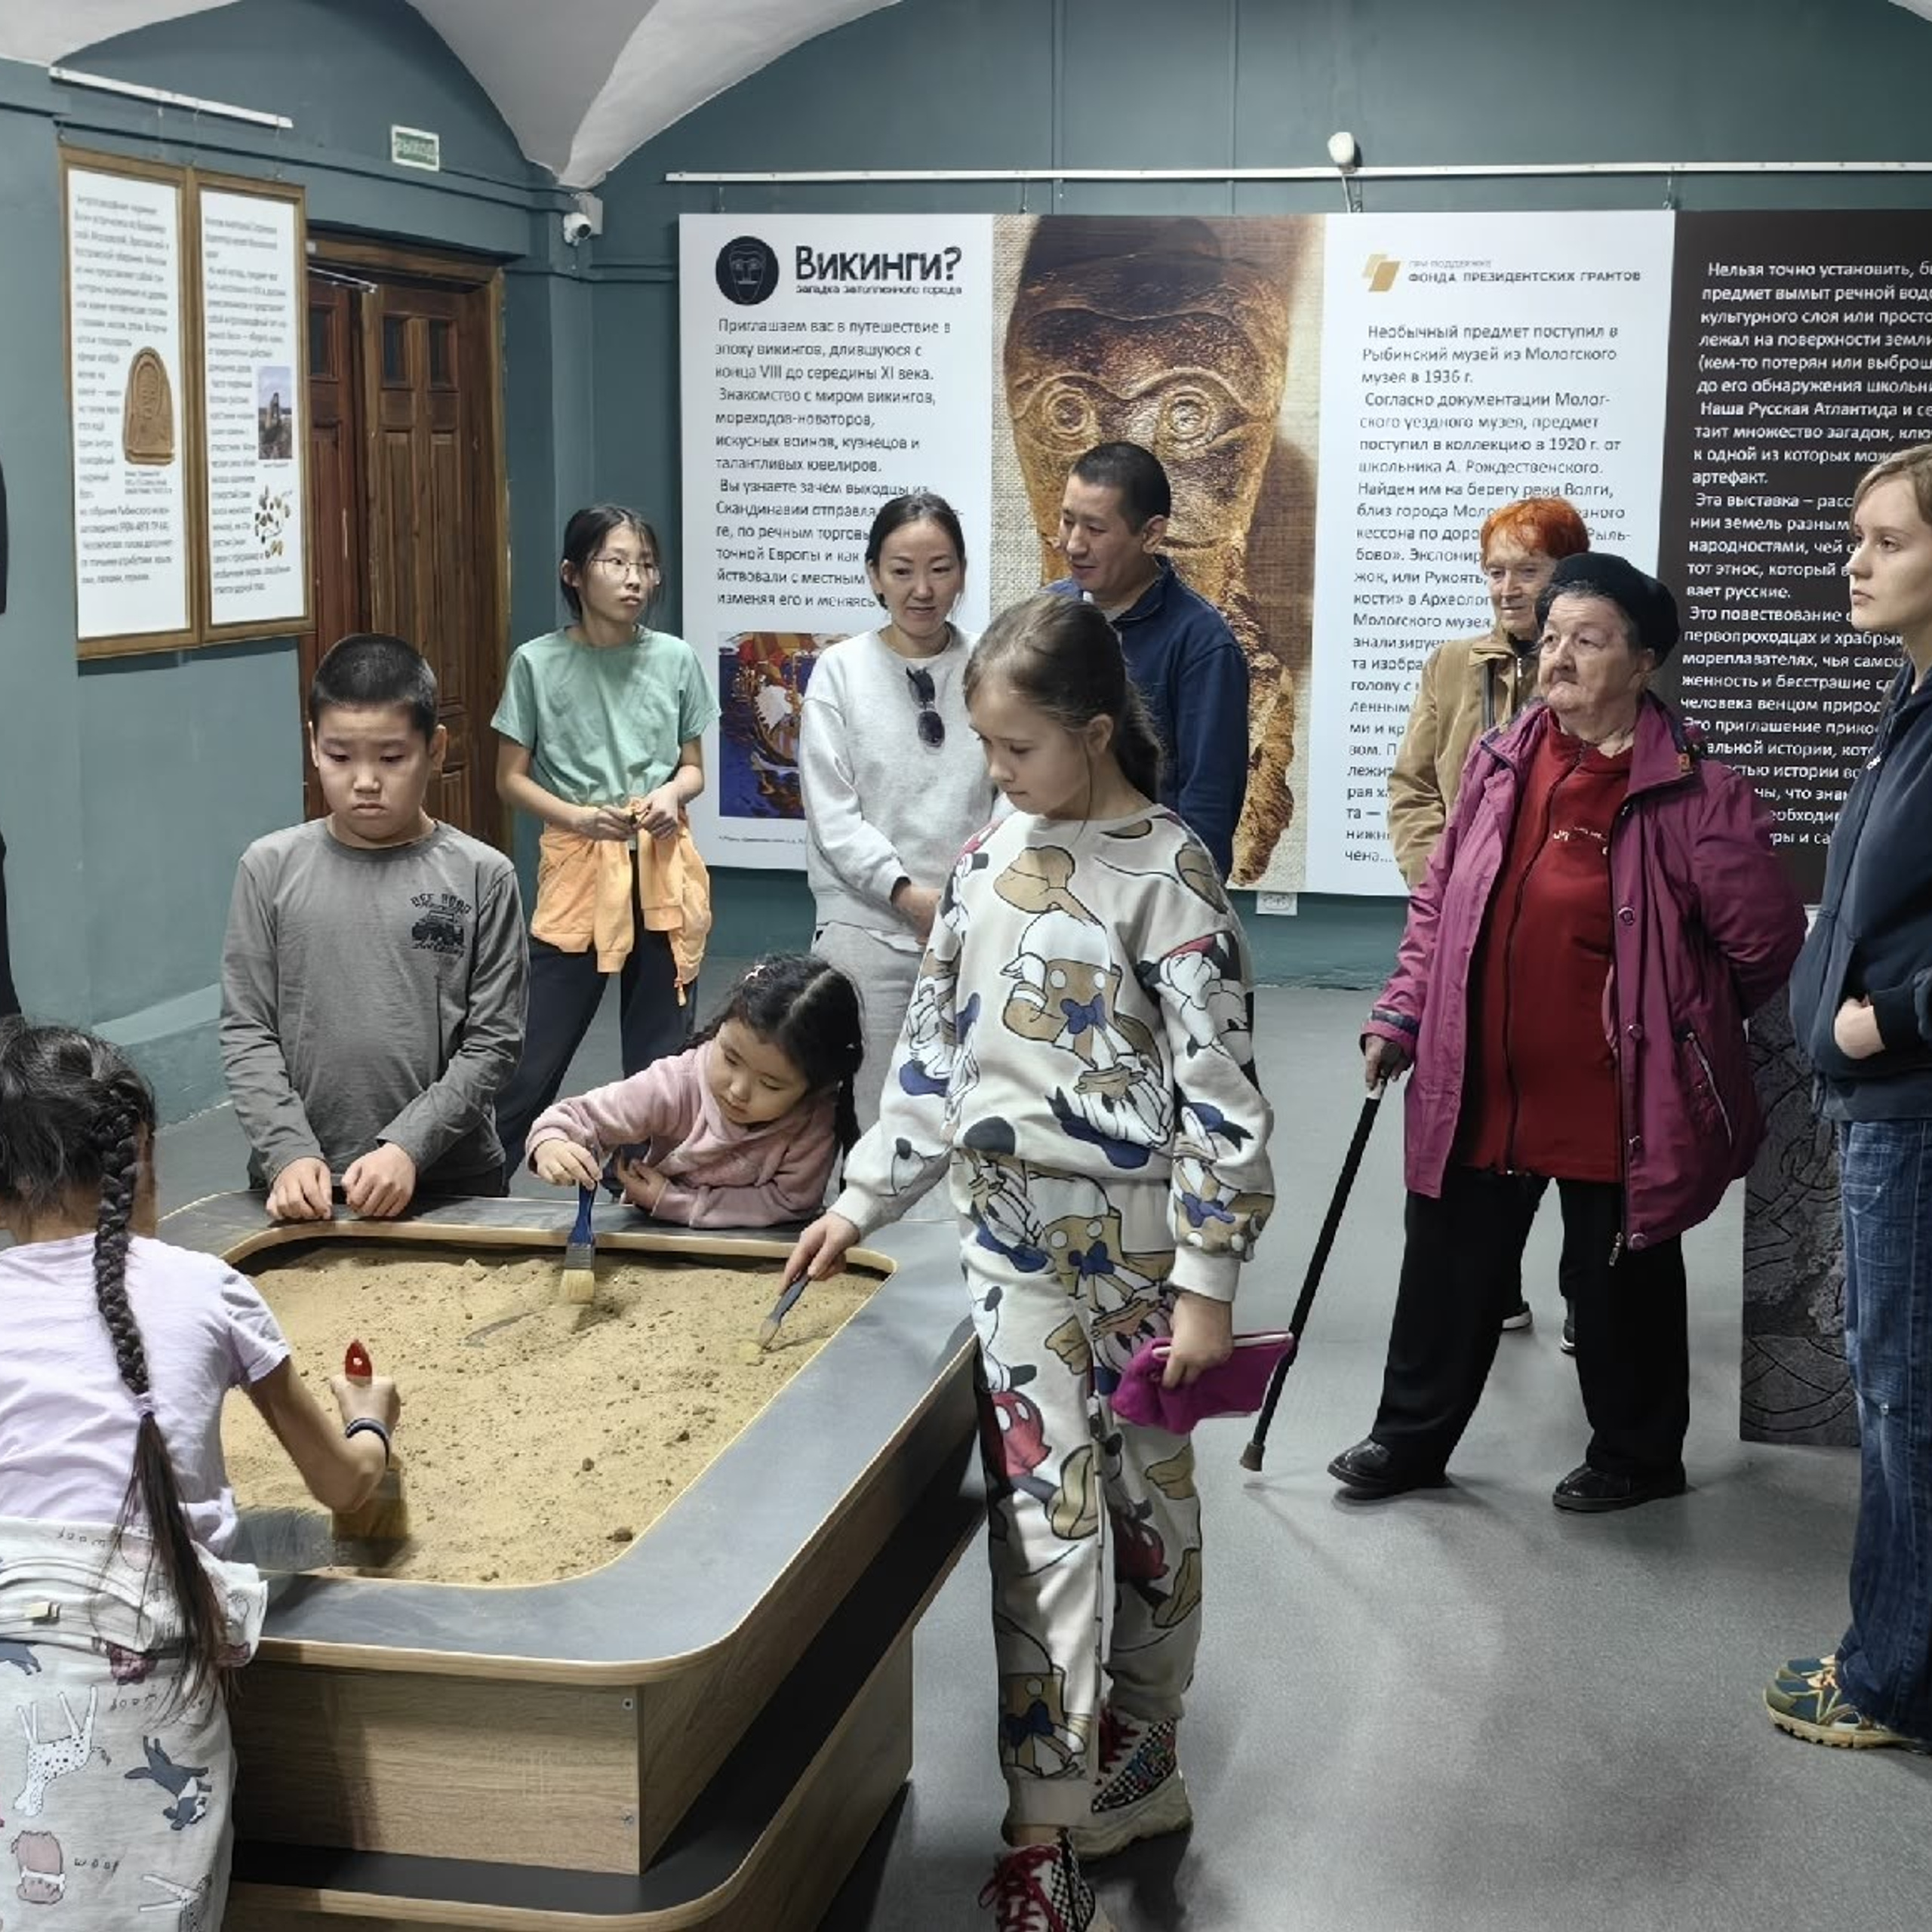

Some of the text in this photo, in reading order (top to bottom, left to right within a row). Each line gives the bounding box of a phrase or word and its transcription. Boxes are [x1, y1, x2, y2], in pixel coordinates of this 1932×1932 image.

[796, 245, 962, 281] Викинги?
[1708, 263, 1914, 278] Нельзя точно установить,
[1408, 272, 1641, 283] ФОНДА ПРЕЗИДЕНТСКИХ ГРАНТОВ
[1702, 285, 1895, 302] предмет вымыт речной
[718, 318, 950, 334] Приглашаем вас в путешествие в
[1700, 312, 1798, 326] культурного
[1801, 312, 1838, 322] слоя
[1843, 312, 1874, 322] или
[1368, 325, 1618, 340] Необычный предмет поступил в
[1699, 334, 1881, 349] лежал на поверхности
[715, 345, 921, 358] эпоху викингов, длившуюся с
[1362, 346, 1617, 362] Рыбинский музей из Мологского
[1698, 354, 1862, 371] (кем-то потерян или
[715, 365, 933, 381] конца VIII до середины XI века.
[1361, 369, 1472, 385] музея в 1936 г.
[1697, 377, 1862, 394] до его обнаружения
[718, 388, 935, 405] Знакомство с миром викингов,
[1364, 392, 1609, 408] Согласно документации Молог-
[1700, 401, 1912, 418] Наша Русская Атлантида и
[715, 414, 875, 426] мореходов-новаторов,
[1360, 417, 1598, 430] ского уездного музея, предмет
[1694, 426, 1894, 441] таит множество загадок,
[715, 436, 919, 450] искусных воинов, кузнецов и
[1360, 438, 1621, 453] поступил в коллекцию в 1920 г. от
[1694, 446, 1850, 464] к одной из которых
[715, 459, 881, 472] талантливых ювелиров.
[1358, 460, 1603, 475] школьника А. Рождественского.
[1692, 470, 1767, 486] артефакт.
[721, 479, 909, 495] Вы узнаете зачем выходцы
[1358, 482, 1613, 498] Найден им на берегу реки Волги,
[1696, 492, 1799, 506] Эта выставка
[716, 501, 808, 516] Скандинавии
[1356, 503, 1447, 519] близ города
[1690, 518, 1782, 529] нии земель
[715, 526, 813, 539] ге, по речным
[1357, 529, 1438, 540] кессона по
[1356, 548, 1404, 560] бово».
[1689, 539, 1842, 554] народностями, чей
[715, 546, 764, 559] точной
[768, 548, 820, 563] Европы
[837, 552, 859, 561] как
[717, 568, 786, 582] йствовали
[1354, 572, 1387, 583] жок,
[1392, 573, 1420, 583] или
[1687, 562, 1835, 578] тот этнос, который
[717, 594, 774, 605] изменяя
[778, 595, 801, 605] его
[804, 597, 813, 605] и
[1354, 594, 1416, 605] кости» в
[1686, 586, 1790, 600] вает русские.
[1353, 614, 1441, 626] Мологского
[1689, 606, 1841, 621] Это повествование
[1684, 631, 1903, 648] первопроходцах и храбрых
[1682, 654, 1849, 667] мореплавателях, чья
[1681, 675, 1870, 691] женность и бесстрашие
[1681, 698, 1818, 712] человека венцом
[1715, 721, 1821, 735] приглашение
